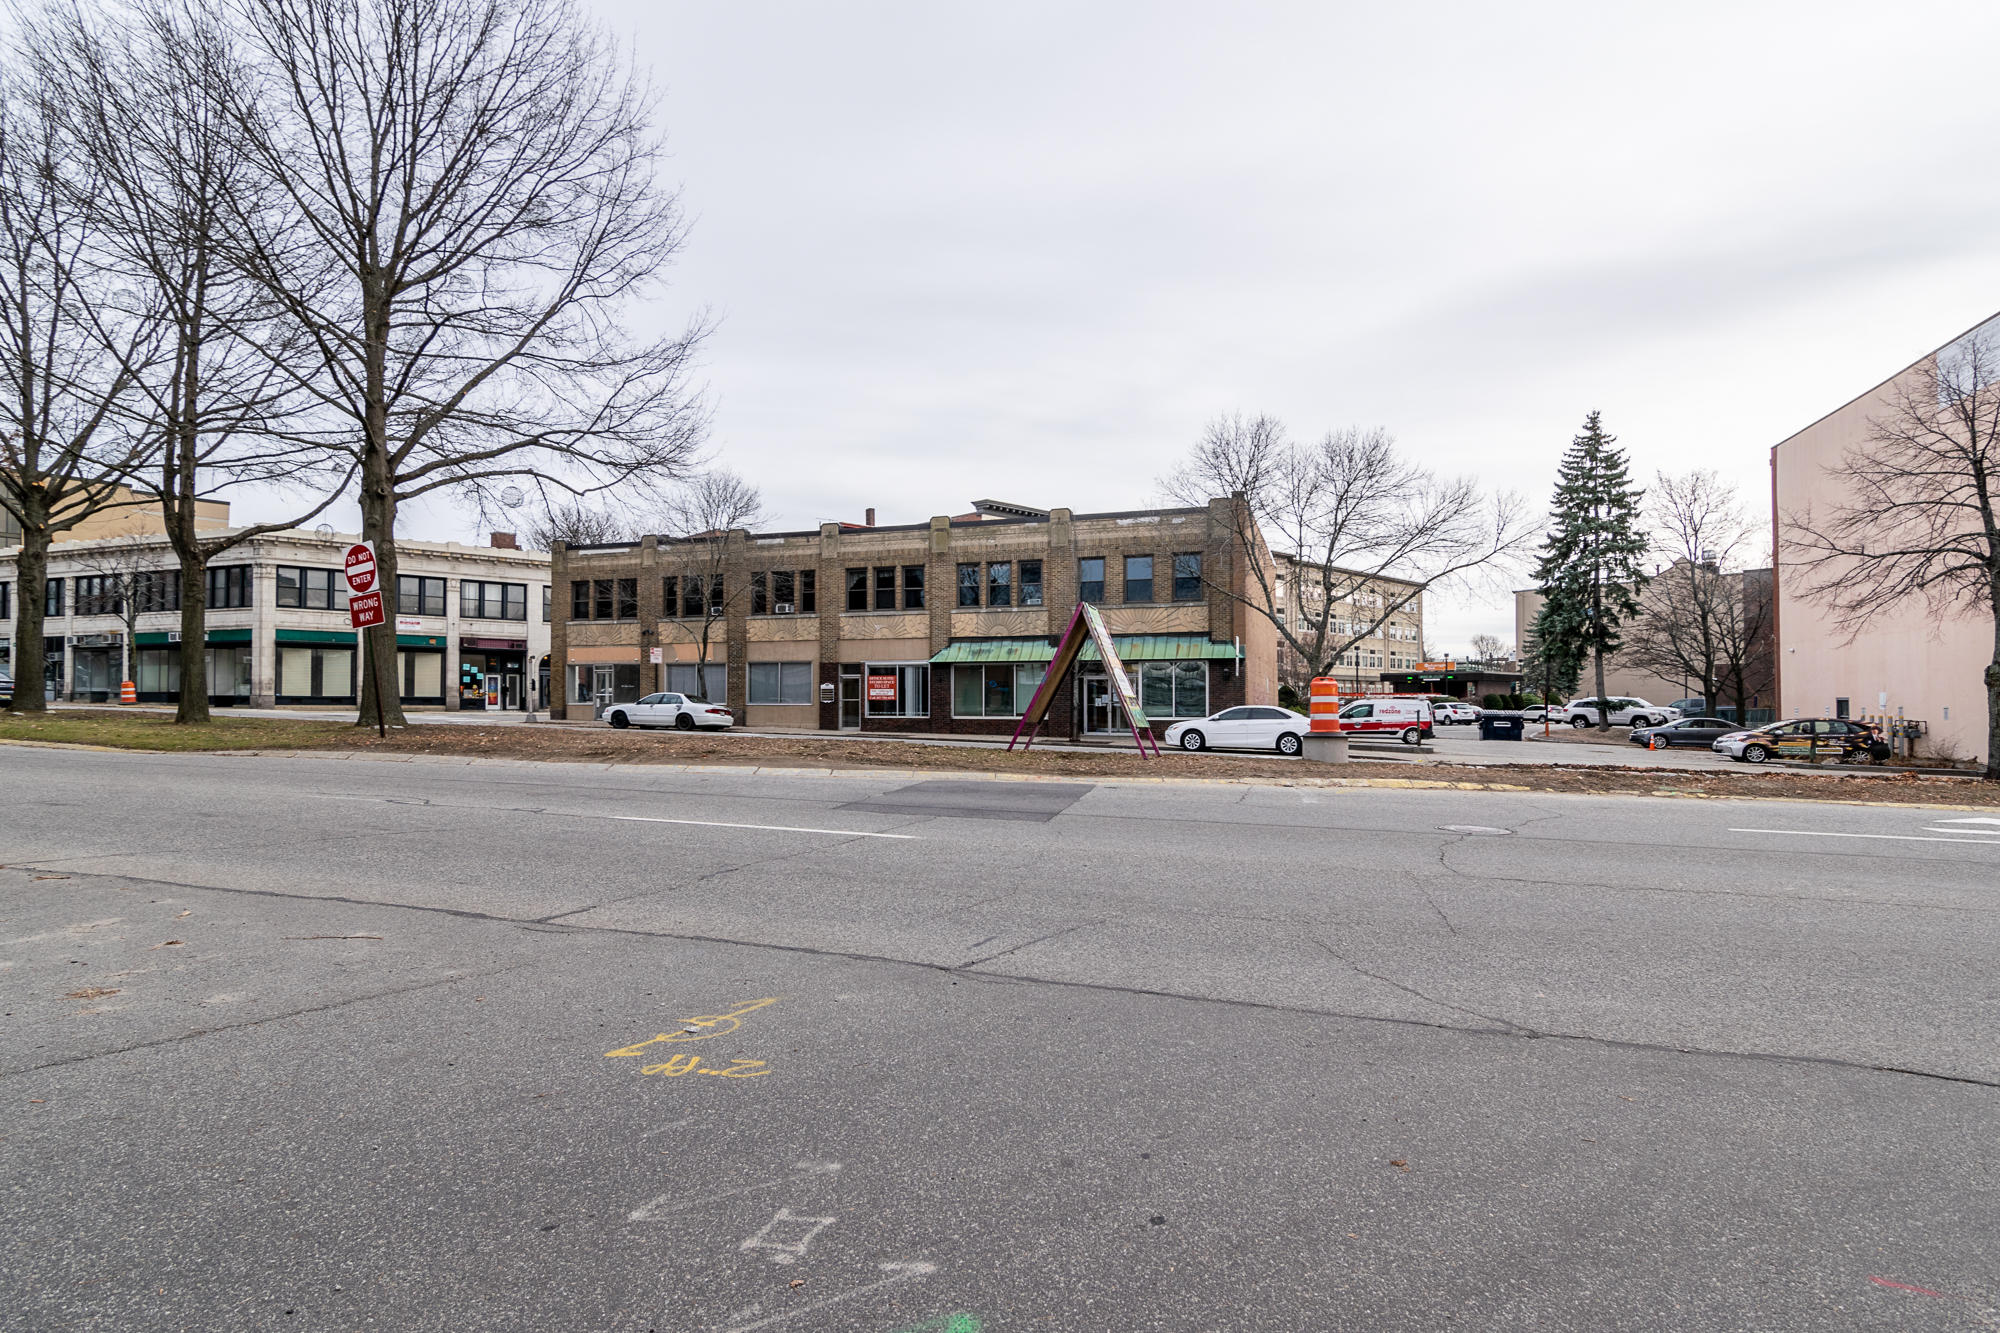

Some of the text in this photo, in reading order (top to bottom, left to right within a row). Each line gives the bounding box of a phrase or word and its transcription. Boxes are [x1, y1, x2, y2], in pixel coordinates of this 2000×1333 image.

[347, 551, 370, 565] DO NOT
[352, 573, 372, 586] ENTER
[352, 597, 379, 612] WRONG
[358, 611, 374, 623] WAY
